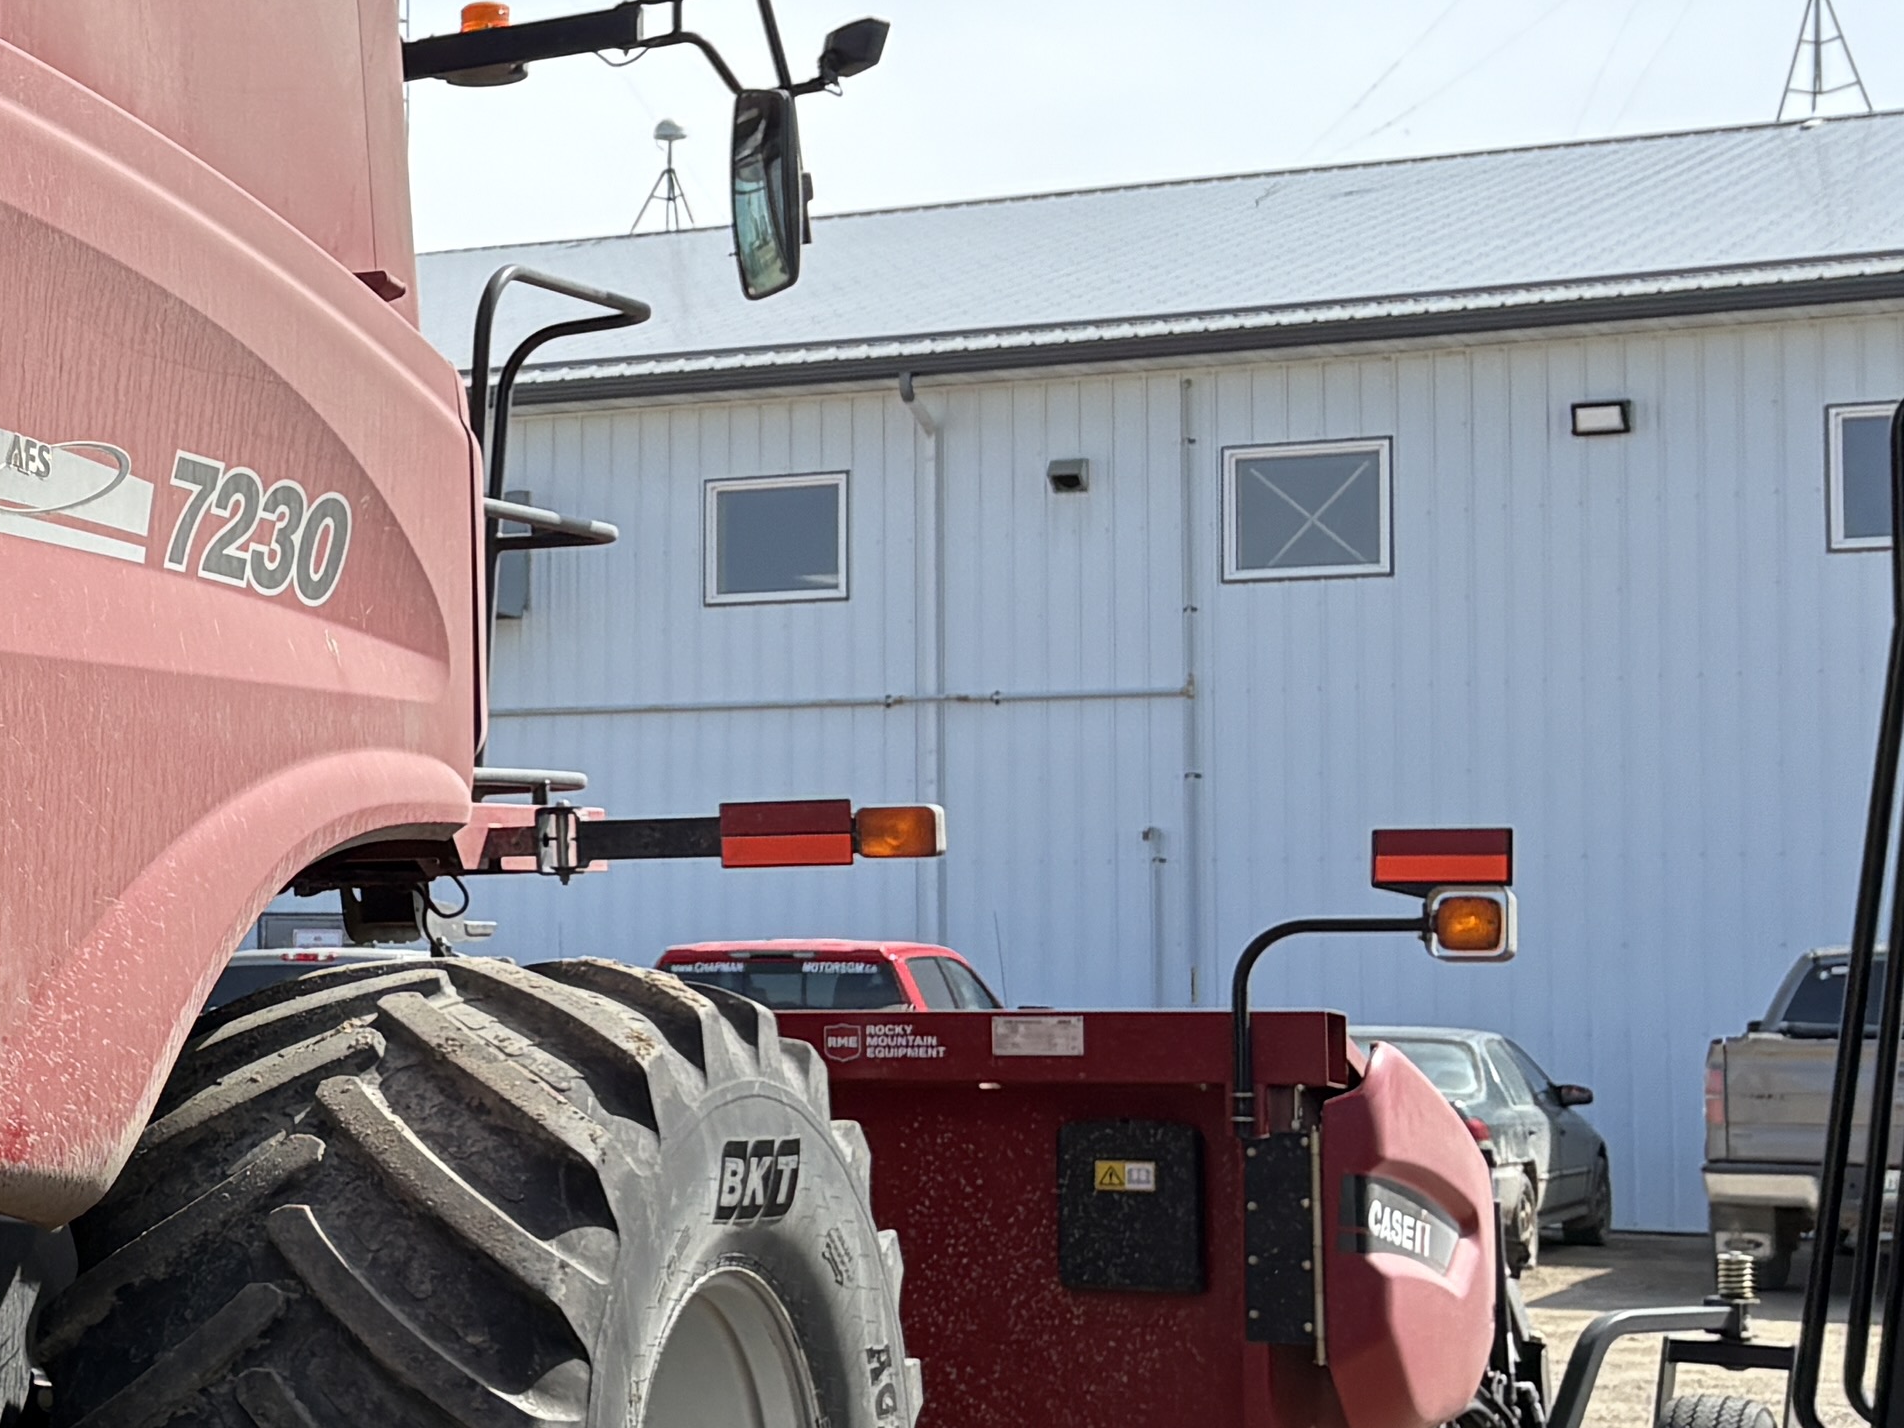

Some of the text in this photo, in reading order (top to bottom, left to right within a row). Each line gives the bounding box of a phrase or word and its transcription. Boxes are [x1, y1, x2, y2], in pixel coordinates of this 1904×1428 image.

[5, 432, 53, 480] AFS
[163, 448, 353, 607] 7230
[827, 1036, 858, 1048] RME
[865, 1024, 913, 1035] ROCKY
[865, 1035, 938, 1046] MOUNTAIN
[866, 1046, 947, 1058] EQUIPMENT
[718, 1152, 800, 1209] BKT
[1367, 1199, 1416, 1252] CASE
